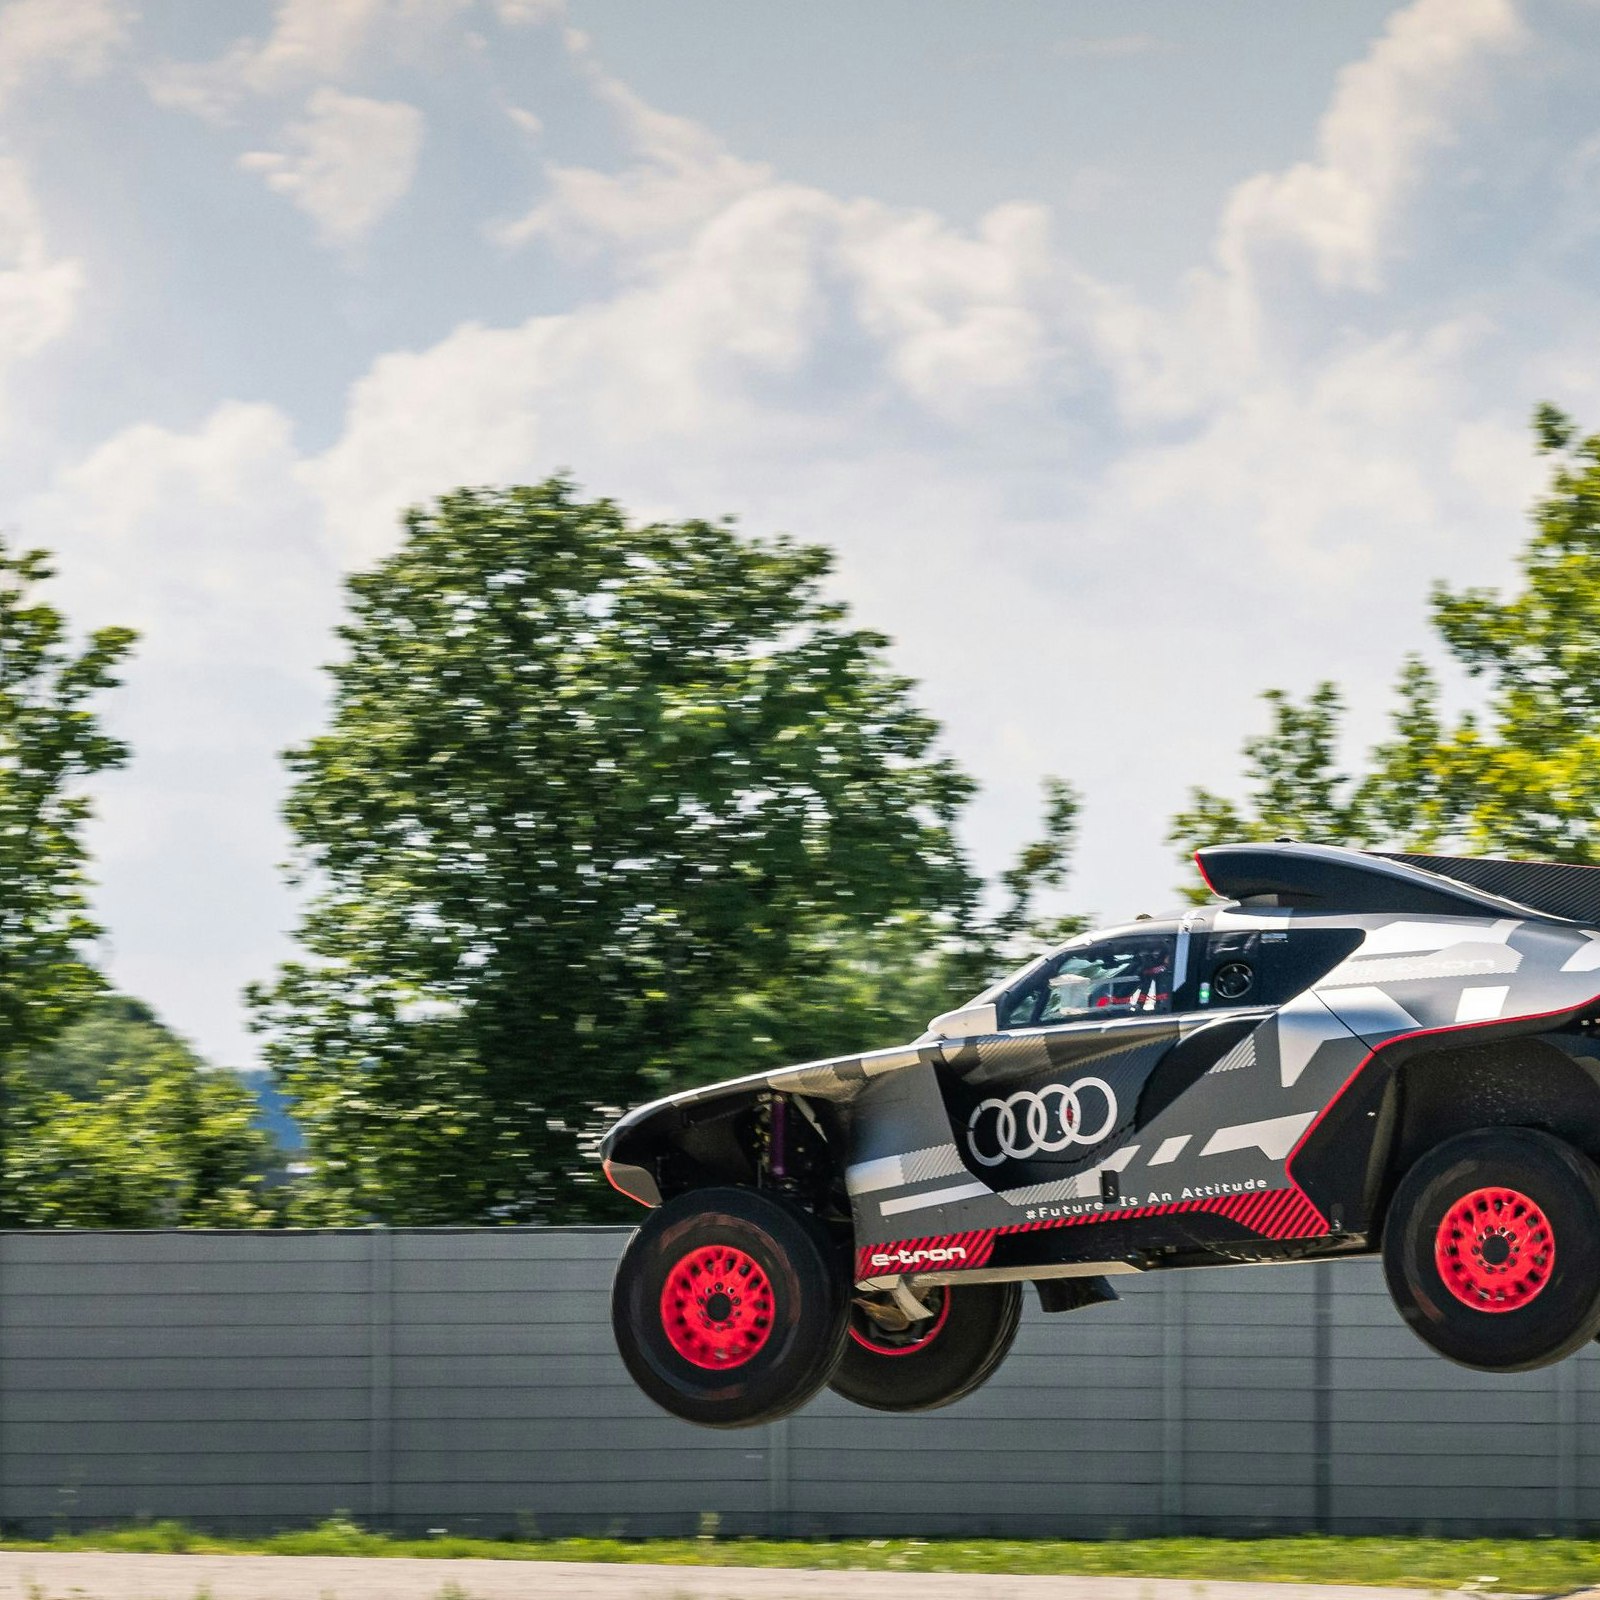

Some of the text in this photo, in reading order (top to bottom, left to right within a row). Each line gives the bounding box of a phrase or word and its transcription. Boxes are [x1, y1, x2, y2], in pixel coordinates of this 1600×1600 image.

[1025, 1178, 1268, 1220] #Future Is An Attitude
[871, 1247, 967, 1267] e-tron
